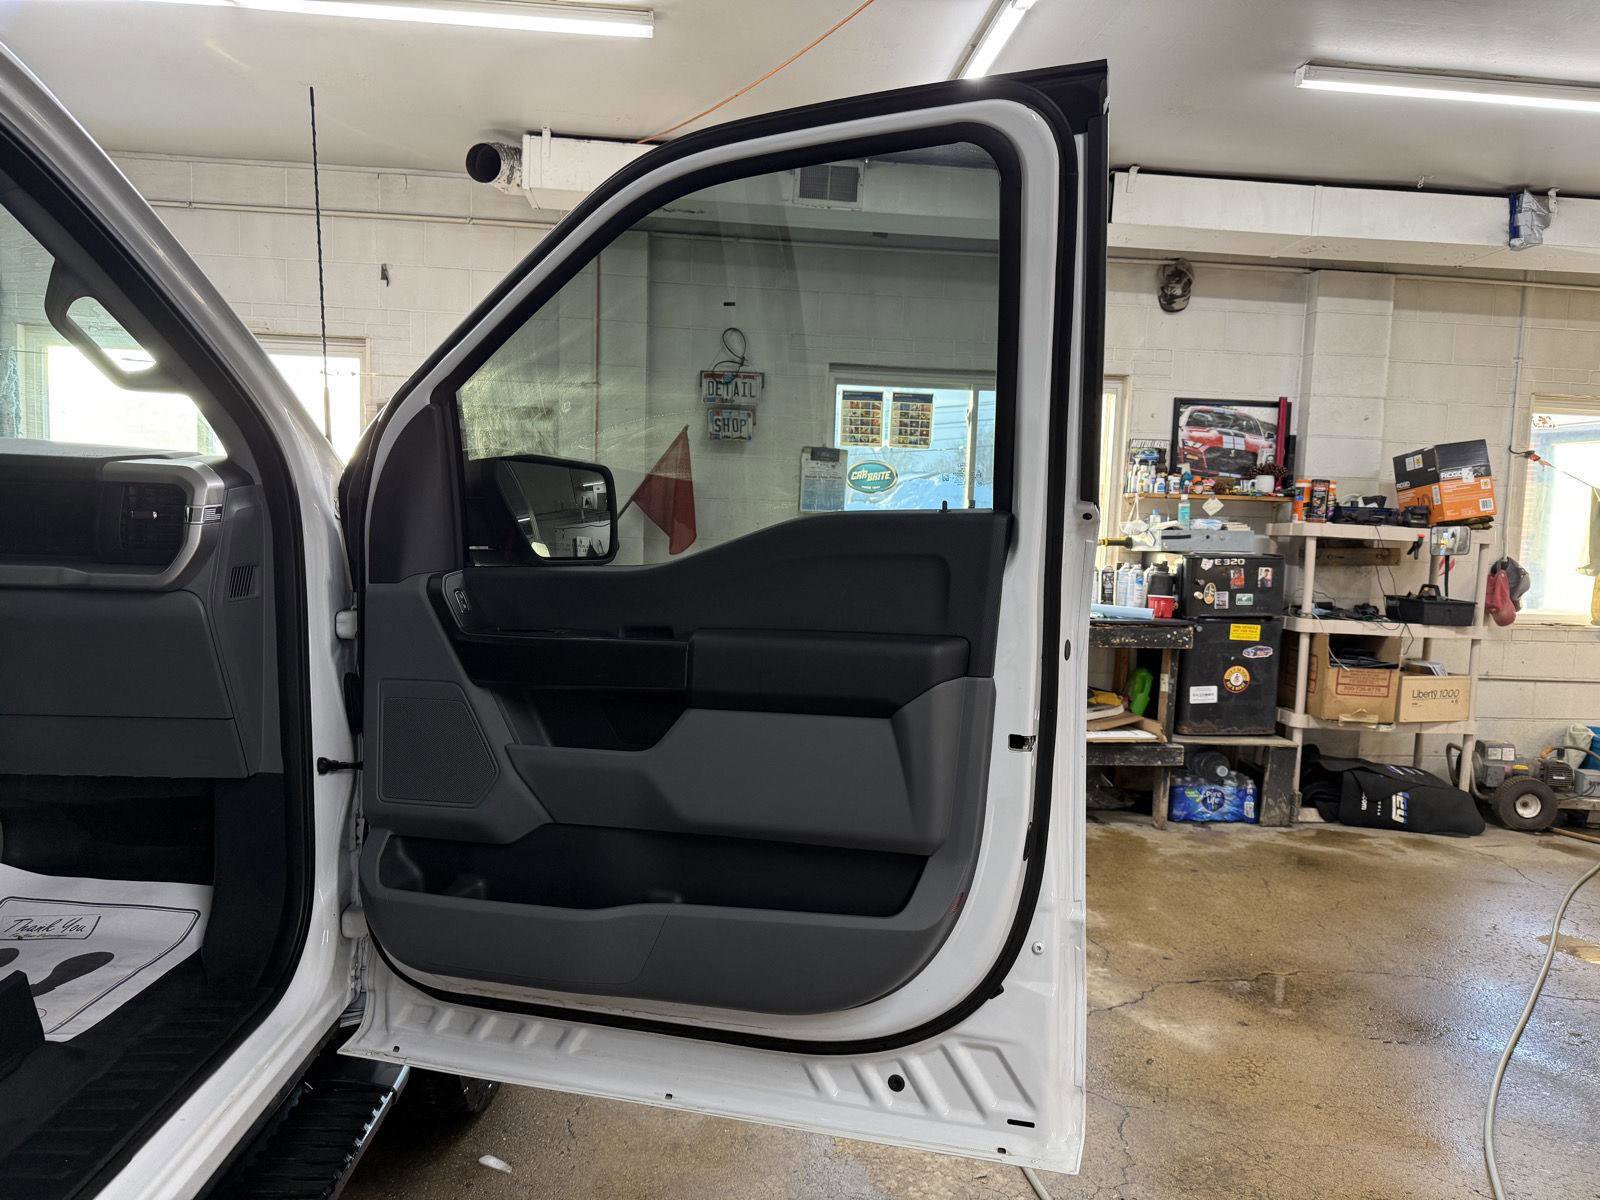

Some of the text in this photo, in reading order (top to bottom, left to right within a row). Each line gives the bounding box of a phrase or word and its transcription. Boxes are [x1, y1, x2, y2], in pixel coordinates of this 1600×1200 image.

[707, 380, 756, 398] DETAIL
[714, 417, 747, 433] SHOP
[867, 470, 891, 482] BRITE
[1411, 688, 1460, 700] Liberty 1000
[4, 917, 87, 934] Thank You
